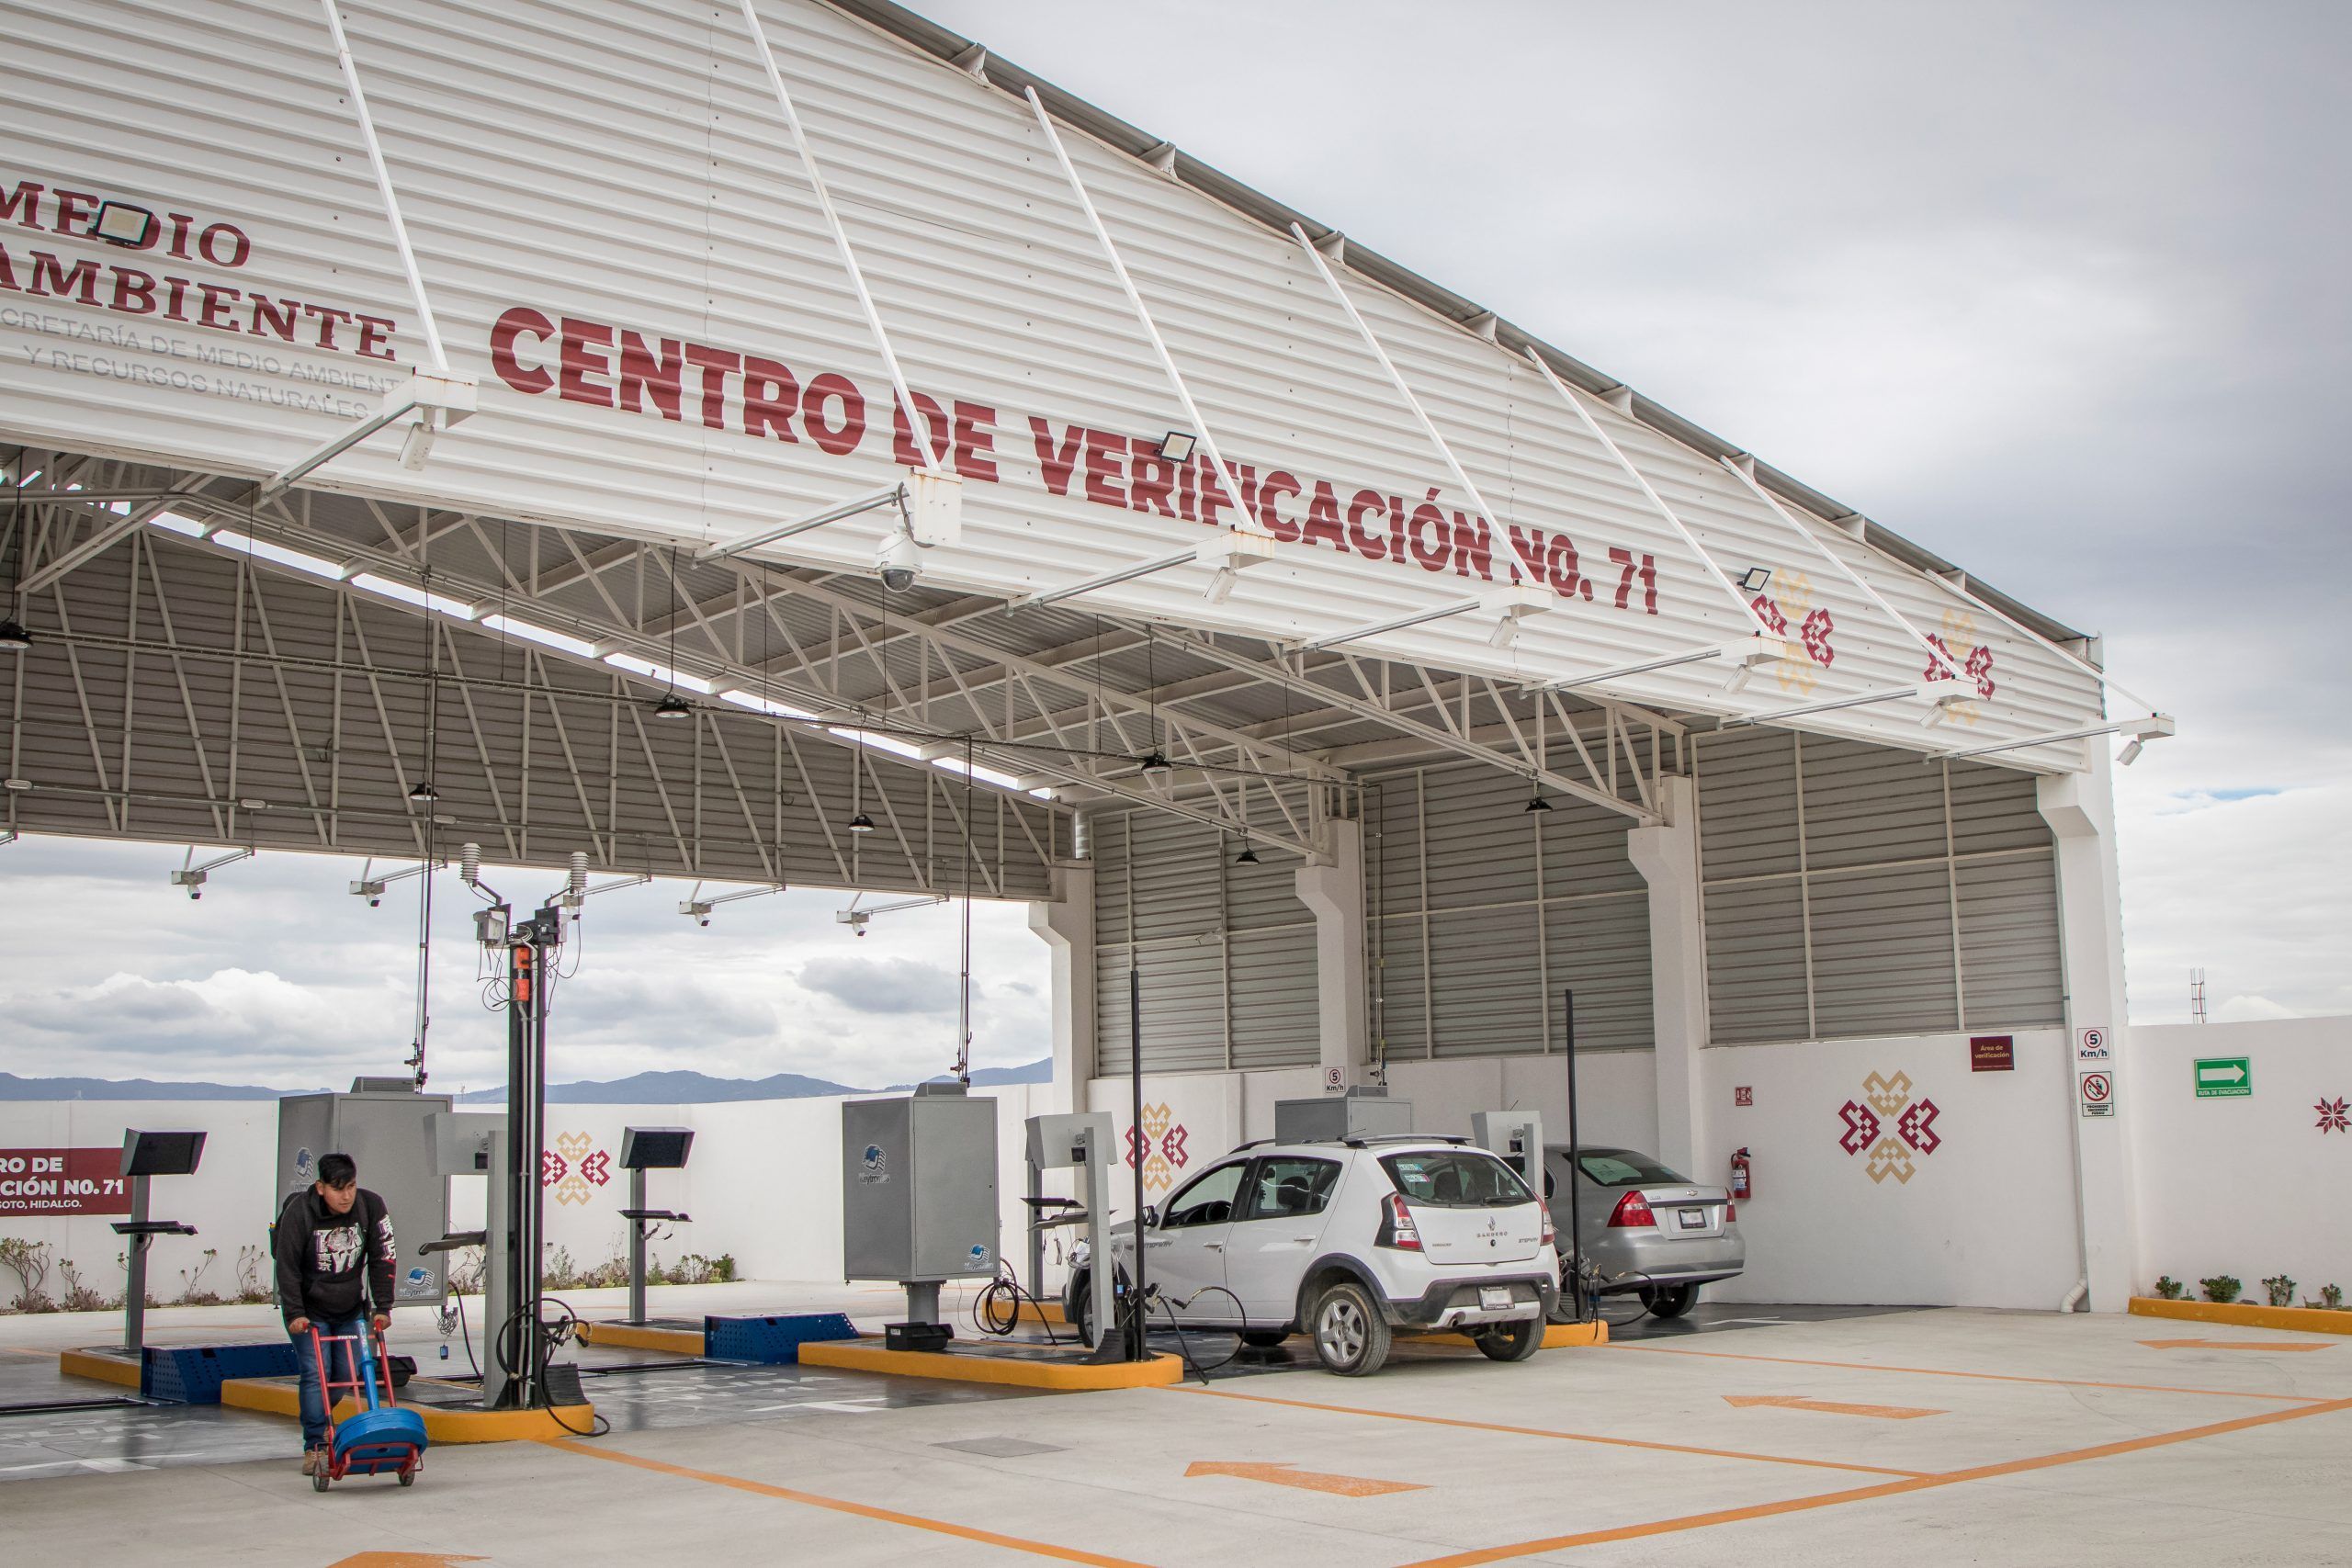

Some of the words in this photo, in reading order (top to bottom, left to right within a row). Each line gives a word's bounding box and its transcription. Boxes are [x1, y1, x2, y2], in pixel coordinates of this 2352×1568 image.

[0, 180, 250, 267] MEIO
[151, 333, 189, 358] DE
[196, 344, 281, 376] MEDIO
[288, 361, 405, 393] AMBIENT
[23, 344, 42, 365] Y
[51, 350, 208, 392] RECURSOS
[217, 378, 368, 419] NATURALES
[490, 307, 865, 456] CENTRO
[893, 388, 999, 483] DE
[1028, 415, 1492, 581] VERIFICACIÓN
[1510, 525, 1593, 602] NO.
[1609, 547, 1657, 615] 71
[2089, 1033, 2098, 1045] 5
[2080, 1048, 2108, 1059] Km/h
[1332, 1072, 1338, 1081] 5
[32, 1157, 63, 1173] DE
[63, 1179, 100, 1195] NO.
[103, 1179, 124, 1195] 71
[0, 1200, 28, 1209] OTO,
[30, 1200, 82, 1209] HIDALGO.
